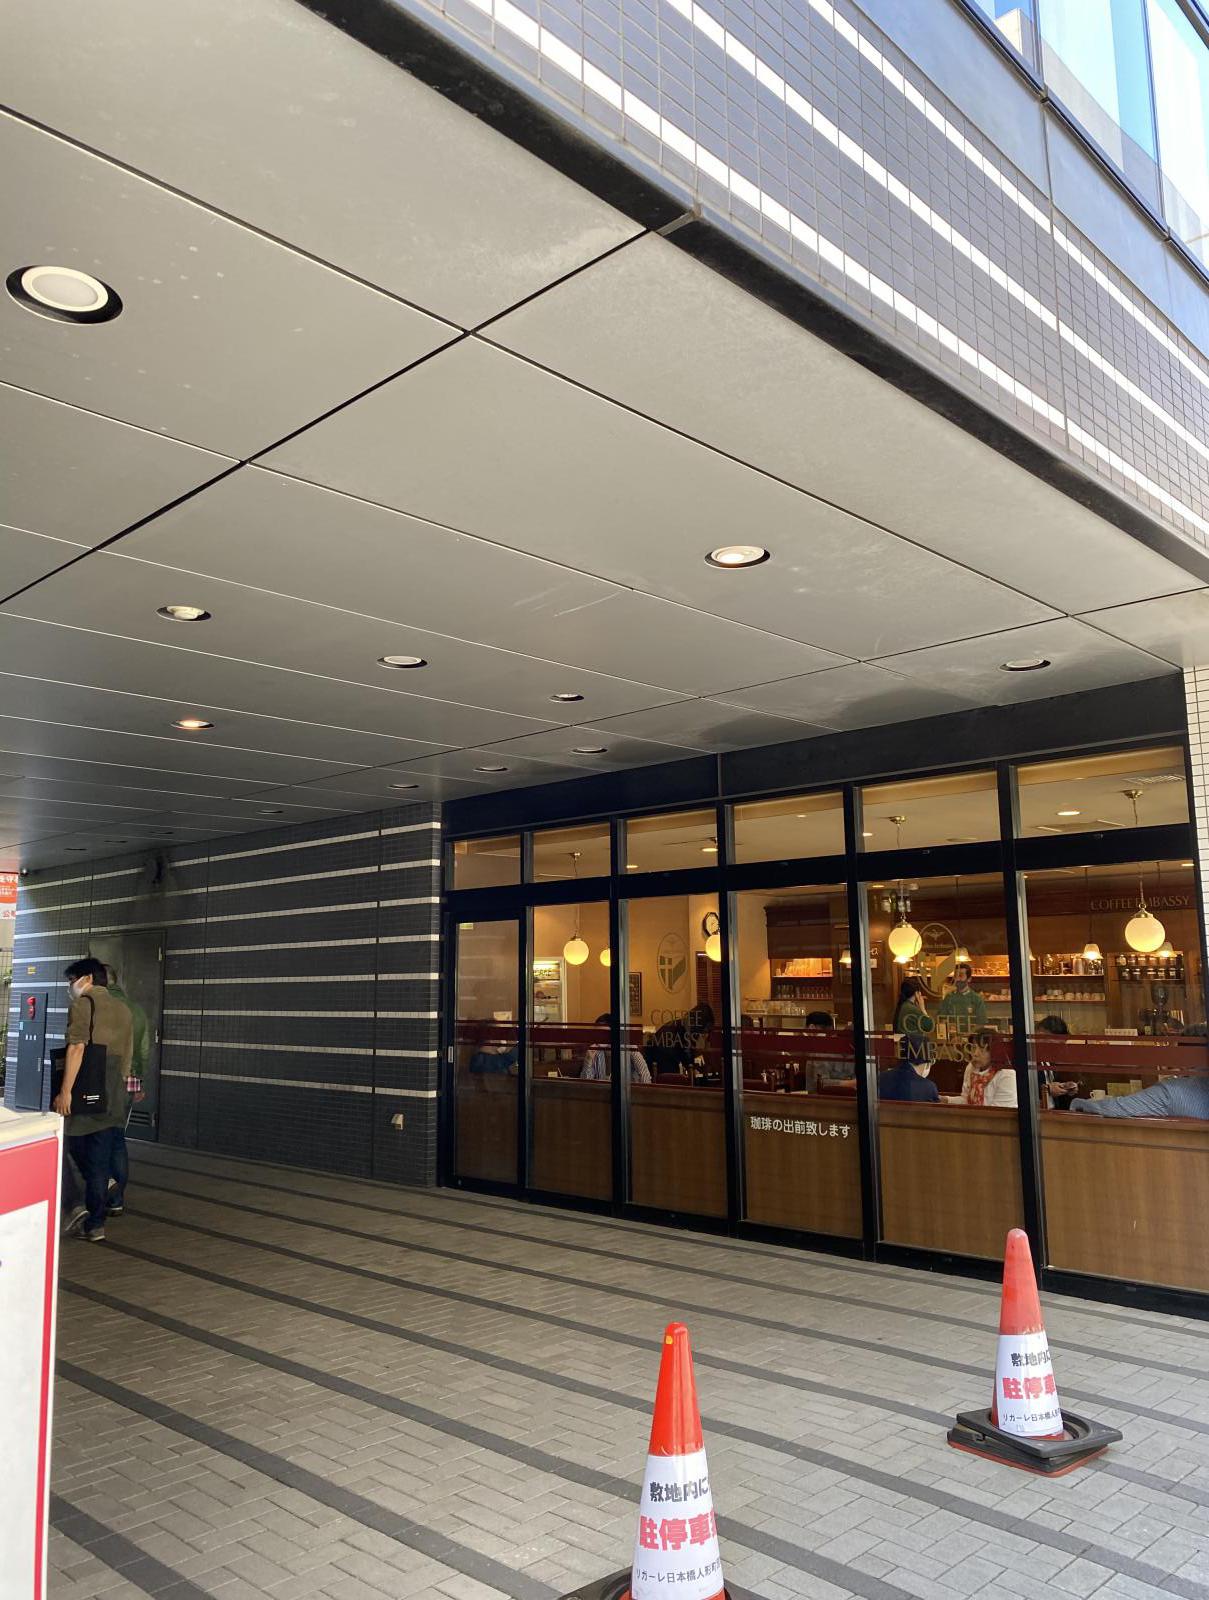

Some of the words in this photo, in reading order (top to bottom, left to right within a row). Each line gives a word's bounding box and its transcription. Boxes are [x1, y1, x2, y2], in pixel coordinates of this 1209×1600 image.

[1090, 898, 1134, 911] COFFEE
[650, 1009, 704, 1028] COFFEE
[903, 1013, 977, 1034] COFFEE
[896, 1040, 989, 1063] EMBASSY
[750, 1116, 850, 1138] 珈琲の出前致します
